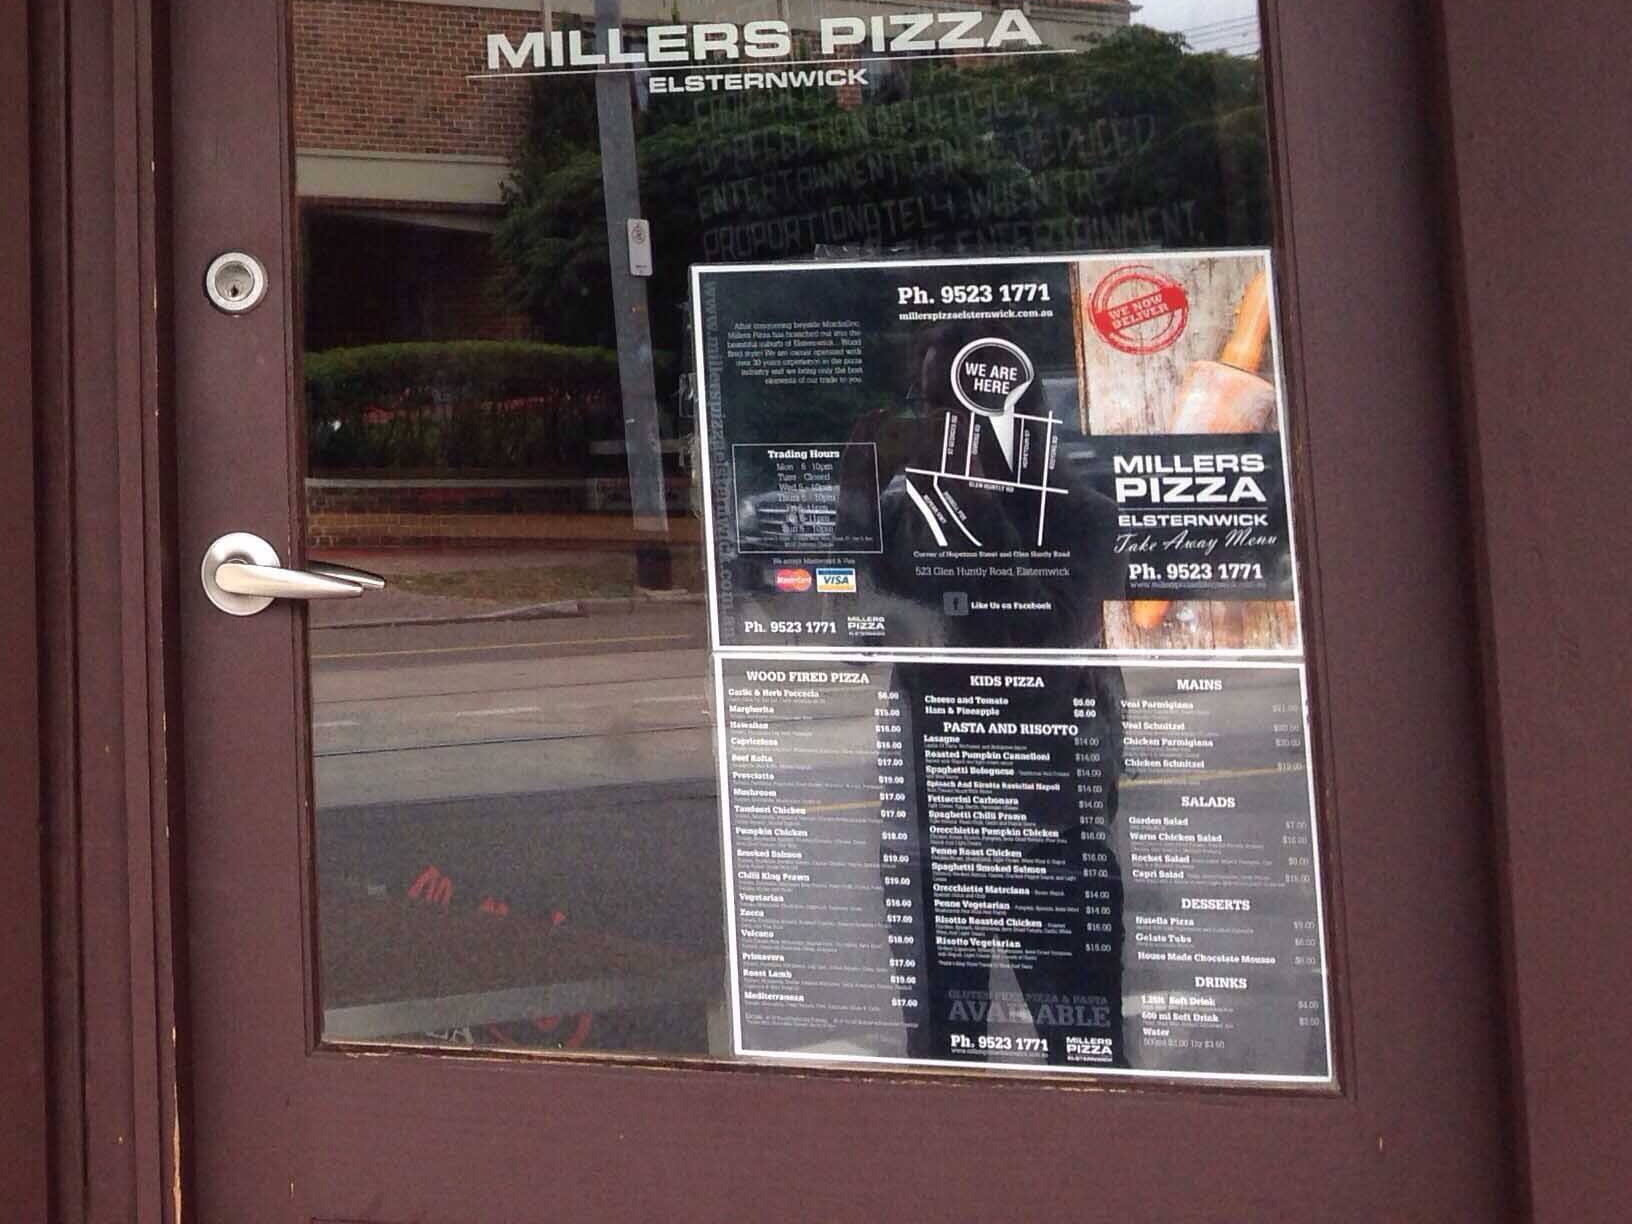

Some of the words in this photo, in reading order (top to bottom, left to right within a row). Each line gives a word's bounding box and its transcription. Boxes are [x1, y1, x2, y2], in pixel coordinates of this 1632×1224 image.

[487, 19, 792, 70] MILLERS
[821, 8, 1043, 55] PIZZA
[648, 68, 868, 93] ELSTERNWICK
[898, 287, 934, 304] Ph.
[941, 285, 992, 304] 9523
[1000, 284, 1050, 301] 1771
[1108, 306, 1129, 320] WE
[1132, 294, 1163, 312] NOW
[1112, 304, 1168, 327] DELIVER
[965, 362, 987, 376] WE
[990, 366, 1018, 381] ARE
[974, 378, 1010, 394] HERE
[768, 450, 807, 459] Trading
[810, 450, 840, 458] Hours
[1113, 454, 1265, 474] MILLERS
[1116, 476, 1266, 503] PIZZA
[1118, 514, 1268, 526] ELSTERNWICK
[1114, 533, 1158, 553] Take
[1163, 529, 1218, 556] Away
[1225, 527, 1277, 548] Menu
[933, 567, 954, 576] Glen
[957, 568, 987, 577] Huntly
[1017, 567, 1069, 576] Elsternwick
[1128, 564, 1162, 580] Ph.
[1166, 564, 1212, 580] 9523
[1218, 564, 1263, 580] 1771
[824, 576, 849, 585] VISA
[990, 602, 1000, 610] Us
[1014, 602, 1051, 610] Facebook
[744, 621, 767, 633] Ph.
[770, 622, 802, 633] 9523
[806, 622, 836, 633] 1771
[747, 671, 785, 682] WOOD
[789, 672, 827, 683] FIRED
[831, 673, 869, 683] PIZZA
[970, 676, 1002, 687] KIDS
[1005, 676, 1045, 687] PIZZA
[1177, 679, 1222, 690] MAINS
[728, 689, 753, 697] Garlic
[763, 689, 781, 697] Herb
[957, 696, 973, 704] and
[975, 697, 1009, 705] Tomato
[1121, 700, 1140, 709] Veal
[1142, 701, 1193, 710] Parmigiana
[729, 705, 774, 714] Margherita
[925, 706, 946, 714] Ham
[956, 707, 1000, 716] Pineapple
[730, 721, 768, 729] Hawaiian
[943, 722, 985, 733] PASTA
[988, 723, 1017, 734] AND
[1020, 724, 1078, 735] RISOTTO
[1123, 722, 1142, 730] Veal
[924, 734, 960, 744] Lasagne
[1123, 738, 1160, 746] Chicken
[1162, 739, 1213, 748] Parmigiana
[732, 754, 749, 762] Beef
[925, 750, 960, 759] Roasted
[962, 751, 1001, 760] Pumpkin
[1125, 759, 1161, 767] Chicken
[926, 766, 968, 775] Spaghetti
[733, 788, 776, 797] Mushroom
[973, 796, 1019, 805] Carbonara
[1181, 797, 1235, 808] SALADS
[929, 810, 971, 819] Spaghetti
[1129, 817, 1161, 825] Garden
[1163, 817, 1188, 826] Salad
[736, 827, 772, 836] Pumpkin
[774, 828, 808, 837] Chicken
[981, 827, 1021, 837] Pumpkin
[1023, 828, 1059, 837] Chicken
[1158, 833, 1195, 842] Chicken
[1197, 834, 1222, 842] Salad
[771, 850, 802, 859] Salmon
[931, 847, 958, 856] Penne
[959, 848, 984, 856] Roast
[986, 849, 1022, 858] Chicken
[1165, 855, 1190, 863] Salad
[932, 863, 974, 872] Spaghetti
[976, 864, 1011, 872] Smoked
[1013, 865, 1046, 874] Salmon
[762, 872, 781, 882] King
[1159, 871, 1184, 879] Salad
[934, 899, 960, 908] Penne
[962, 900, 1010, 910] Vegetarian
[1181, 898, 1250, 911] DESSERTS
[935, 915, 966, 924] Risotto
[969, 916, 1004, 925] Roasted
[1006, 917, 1042, 926] Chicken
[936, 937, 968, 946] Risotto
[970, 938, 1021, 948] Vegetarian
[1194, 953, 1239, 962] Chocolate
[1195, 976, 1248, 989] DRINKS
[1190, 998, 1215, 1006] Drink
[1173, 1012, 1191, 1021] Soft
[1193, 1013, 1218, 1022] Drink
[1143, 1028, 1170, 1036] Water
[950, 1034, 975, 1048] Ph.
[978, 1036, 1012, 1049] 9523
[1016, 1038, 1048, 1051] 1771
[1066, 1037, 1112, 1045] MILLERS
[1066, 1045, 1112, 1055] PIZZA
